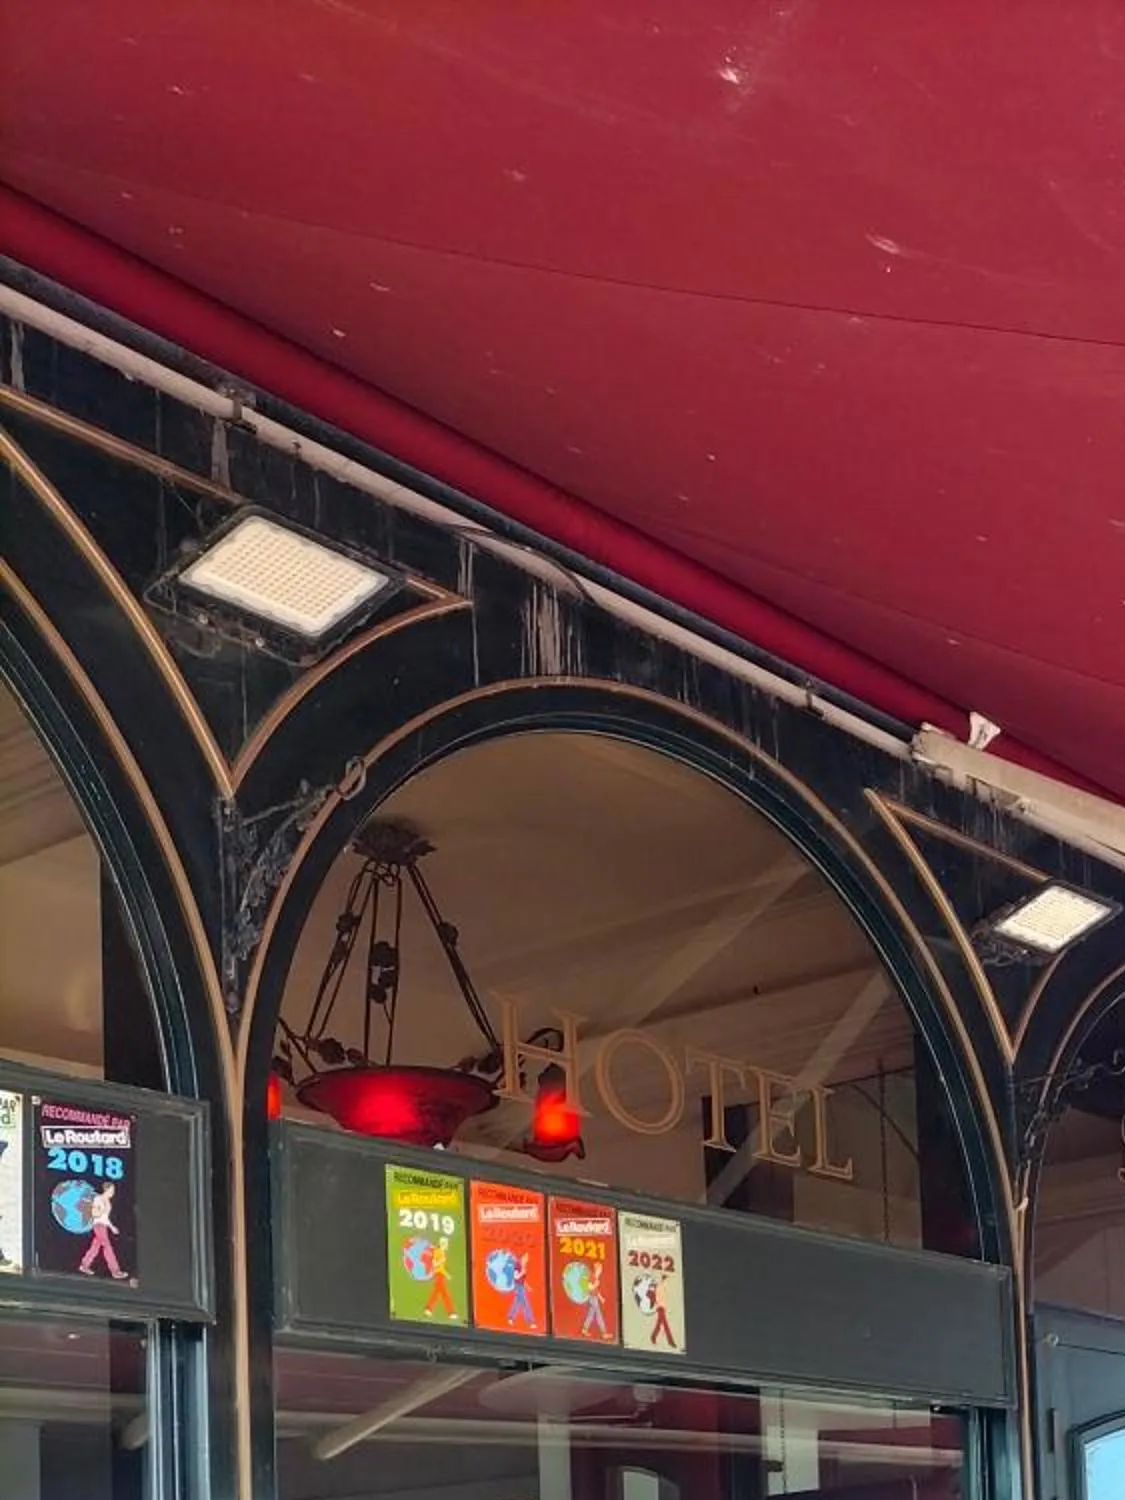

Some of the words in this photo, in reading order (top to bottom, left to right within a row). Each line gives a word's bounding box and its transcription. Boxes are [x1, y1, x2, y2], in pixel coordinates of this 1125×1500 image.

[488, 990, 854, 1181] HOTEL
[47, 1146, 124, 1180] 2018
[398, 1208, 456, 1236] 2019
[560, 1236, 606, 1260] 2021
[628, 1249, 675, 1273] 2022
